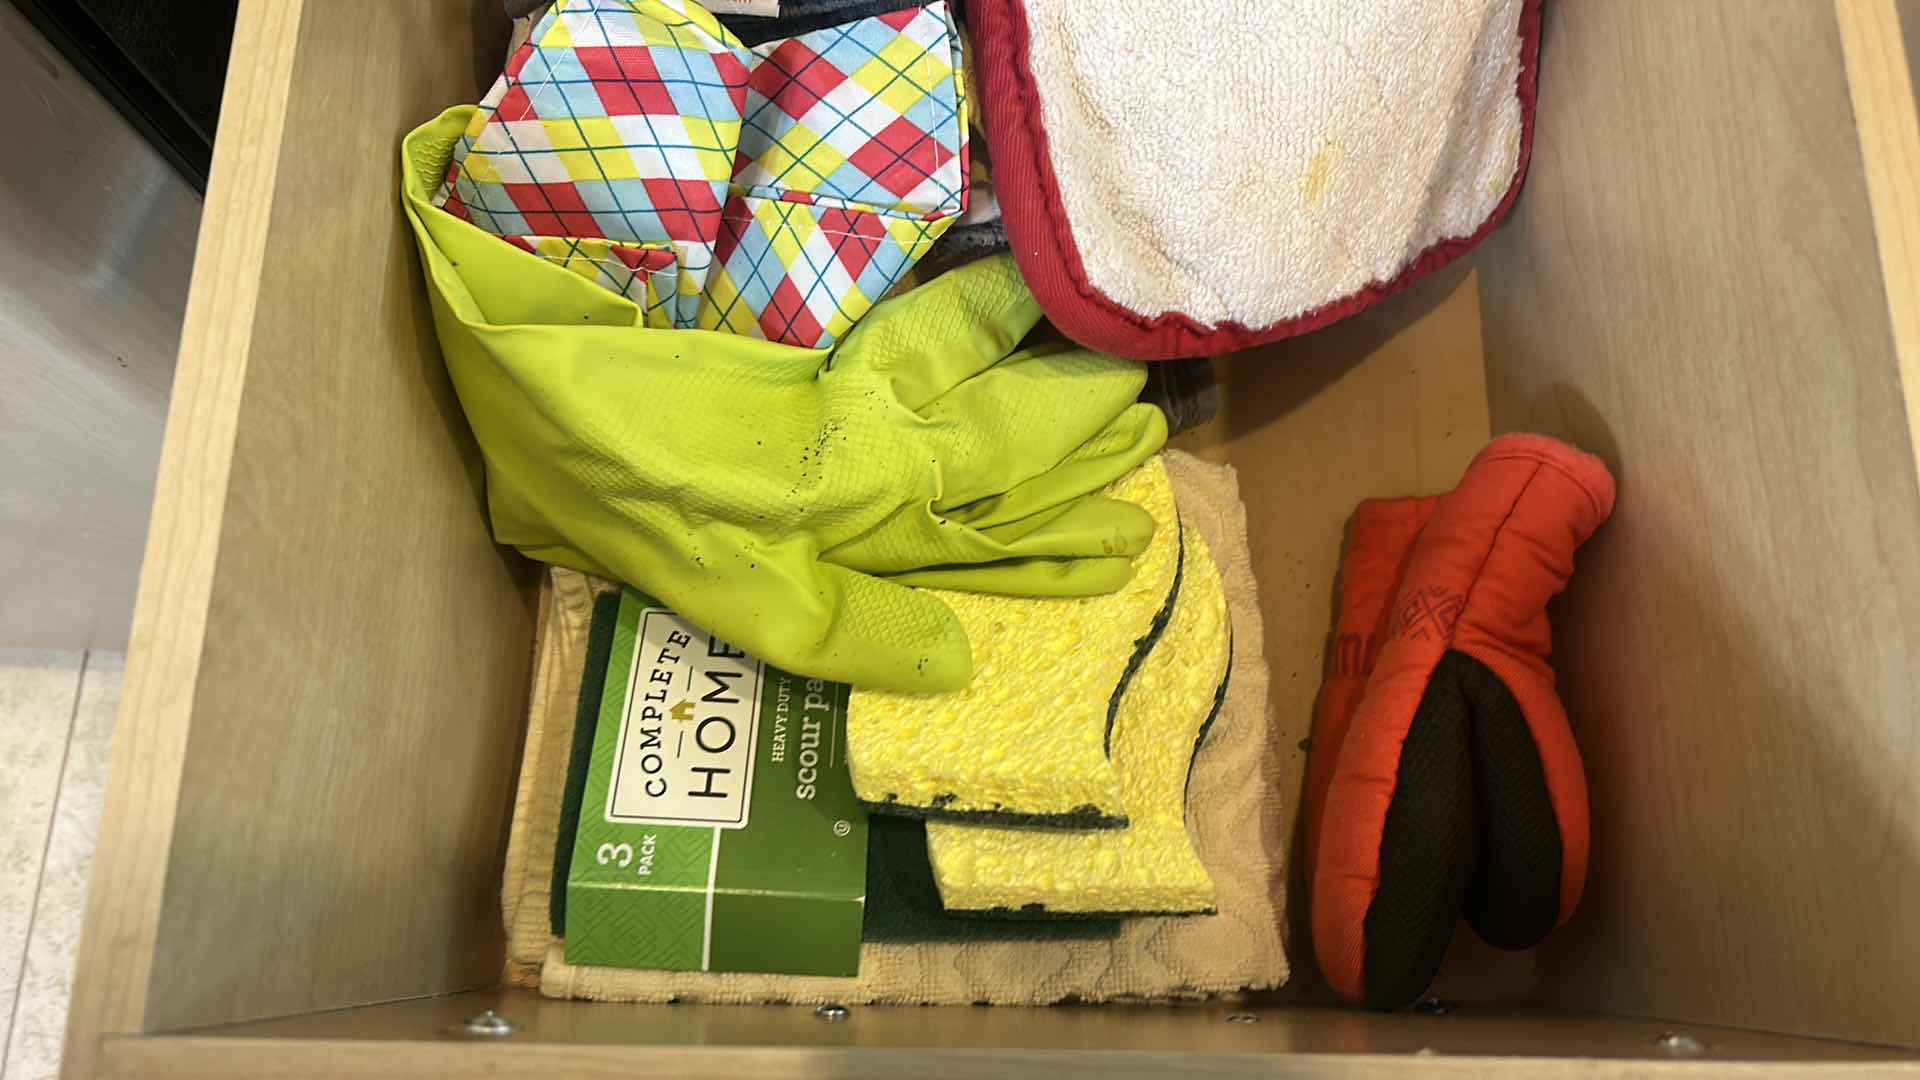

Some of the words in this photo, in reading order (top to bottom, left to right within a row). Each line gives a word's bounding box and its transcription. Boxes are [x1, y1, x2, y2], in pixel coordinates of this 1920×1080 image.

[640, 630, 692, 798] COMPLETE
[776, 676, 792, 712] DUTY
[804, 679, 831, 713] pa
[771, 713, 788, 763] HEAVY
[796, 715, 821, 800] scour
[596, 843, 633, 869] 3
[638, 834, 657, 875] PACK
